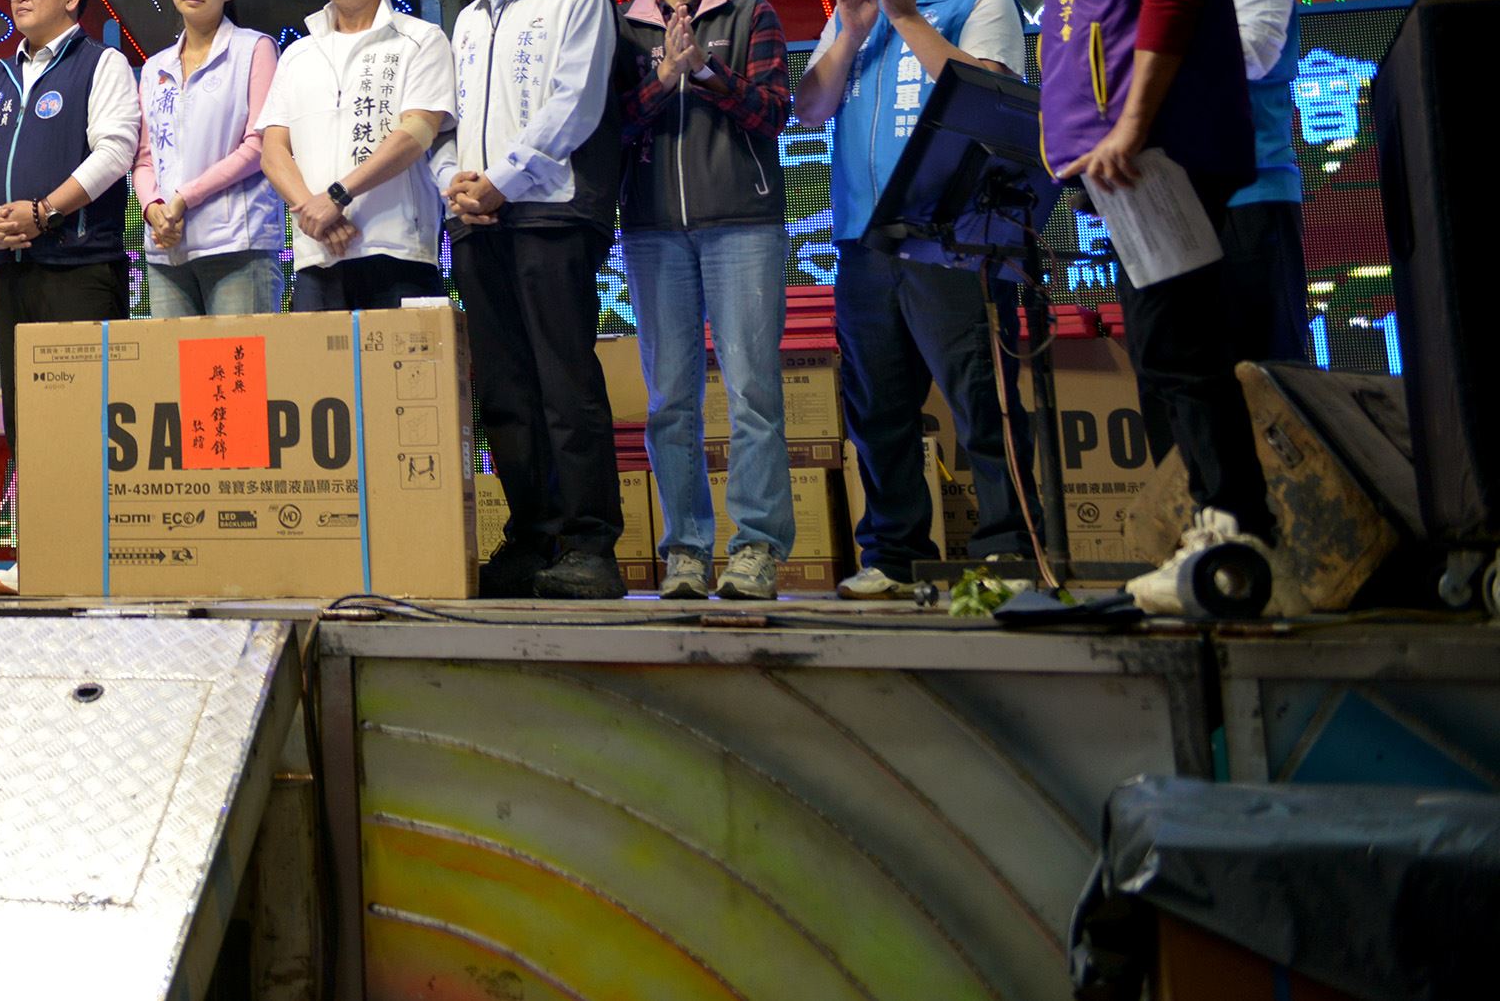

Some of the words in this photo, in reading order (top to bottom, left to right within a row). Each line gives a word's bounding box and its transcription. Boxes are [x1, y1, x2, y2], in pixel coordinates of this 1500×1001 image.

[379, 53, 399, 143] 頭份市民代
[46, 371, 75, 383] Dolby
[108, 397, 351, 472] SAPO
